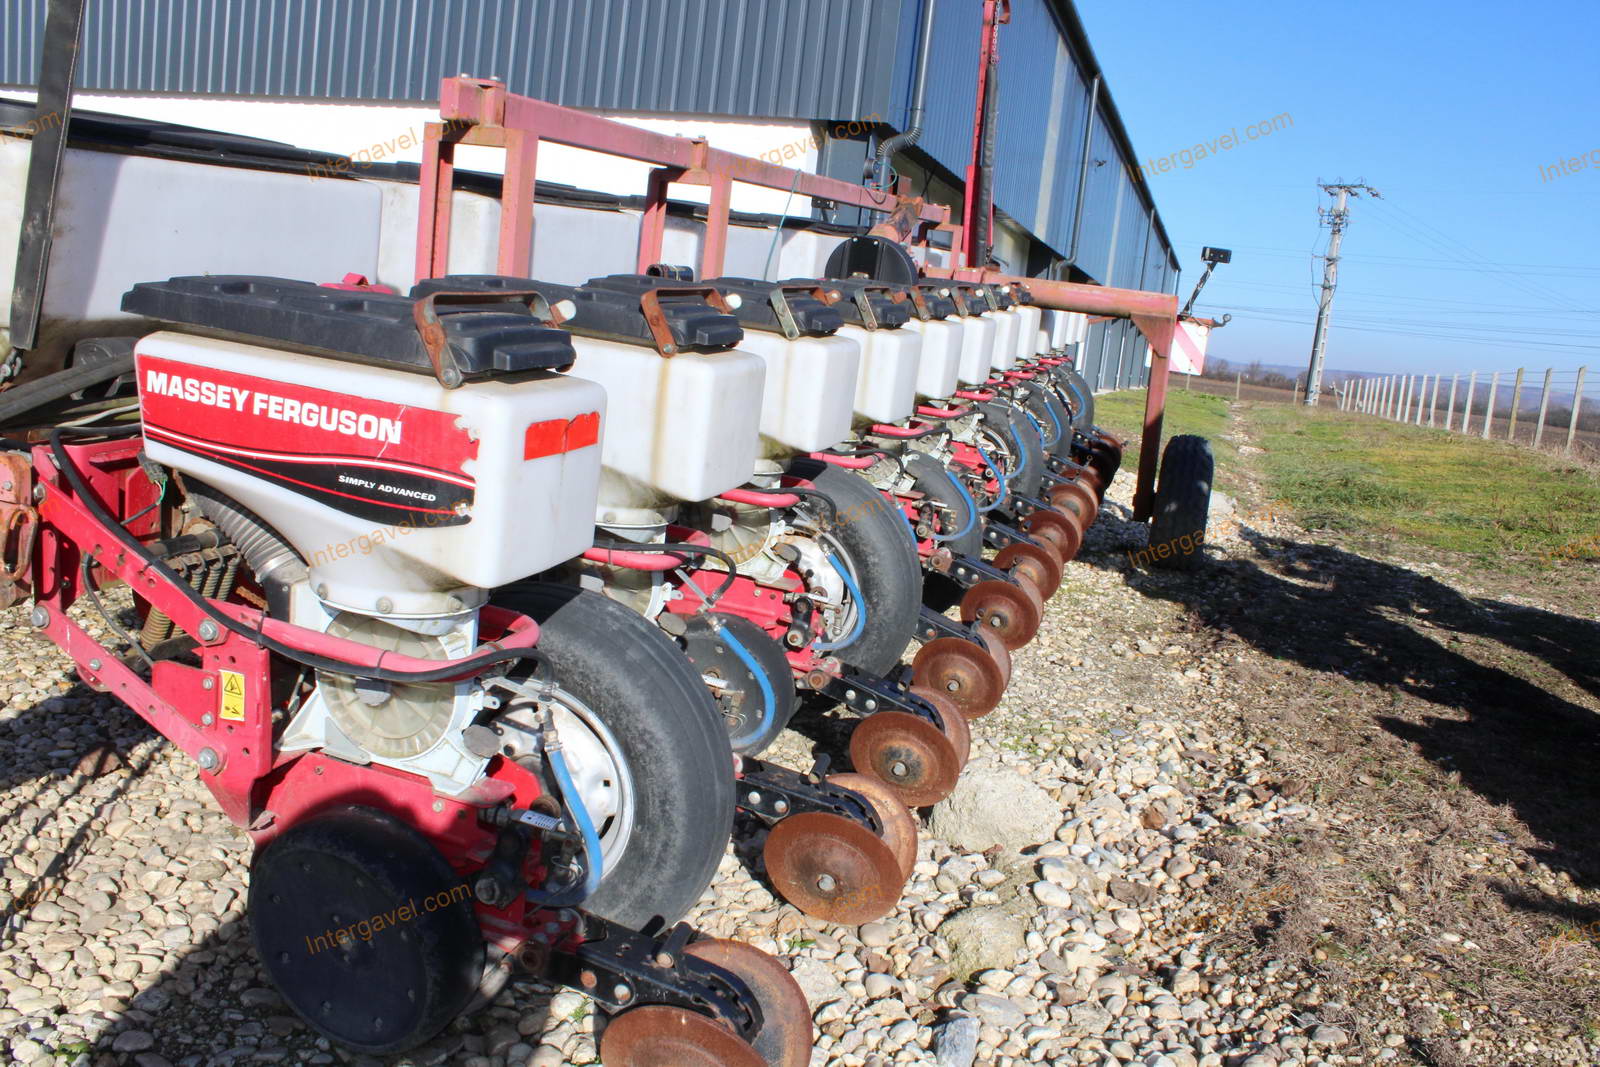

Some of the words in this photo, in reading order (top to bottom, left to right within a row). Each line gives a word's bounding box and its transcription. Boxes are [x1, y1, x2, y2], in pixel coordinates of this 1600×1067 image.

[146, 370, 249, 412] MASSEY
[252, 396, 403, 445] FERGUSON
[338, 475, 376, 489] SIMPLY
[378, 484, 437, 502] ADVANCED
